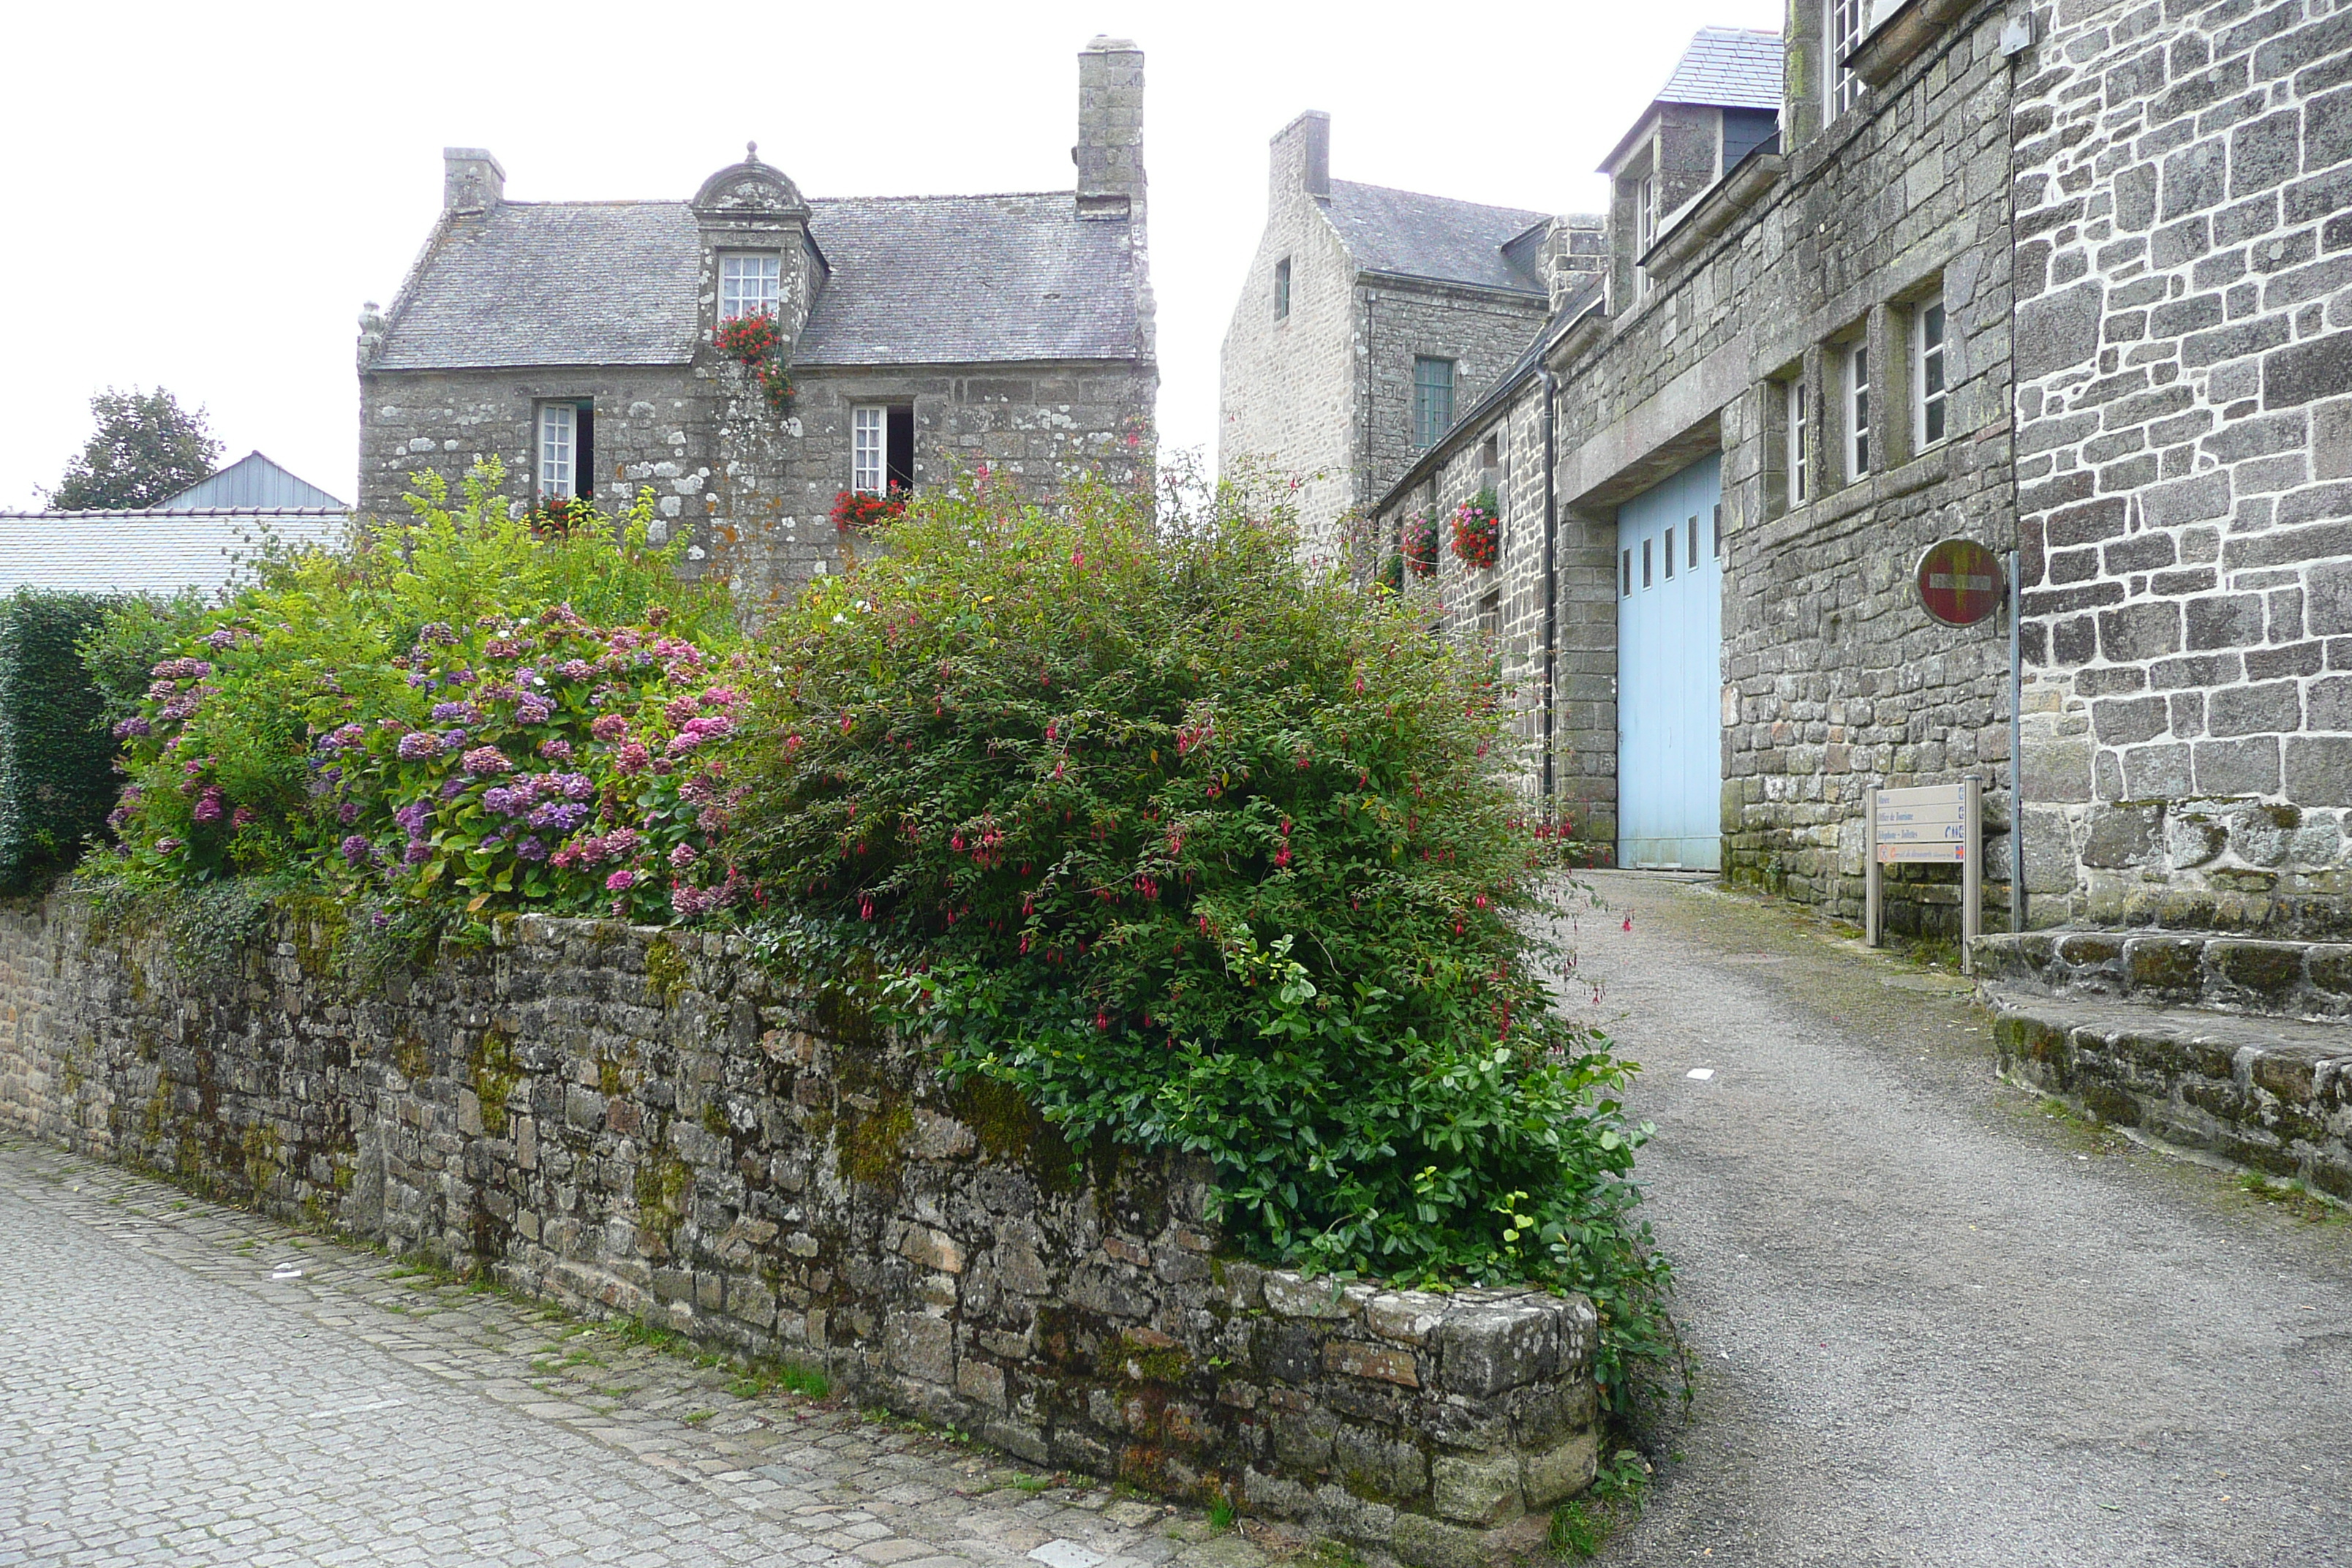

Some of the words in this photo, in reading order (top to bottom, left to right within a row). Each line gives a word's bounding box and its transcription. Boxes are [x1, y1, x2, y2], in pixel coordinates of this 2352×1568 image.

[1877, 812, 1889, 821] Office
[1890, 812, 1895, 821] de
[1896, 811, 1914, 821] Tourisme
[1901, 829, 1918, 839] Toilettes
